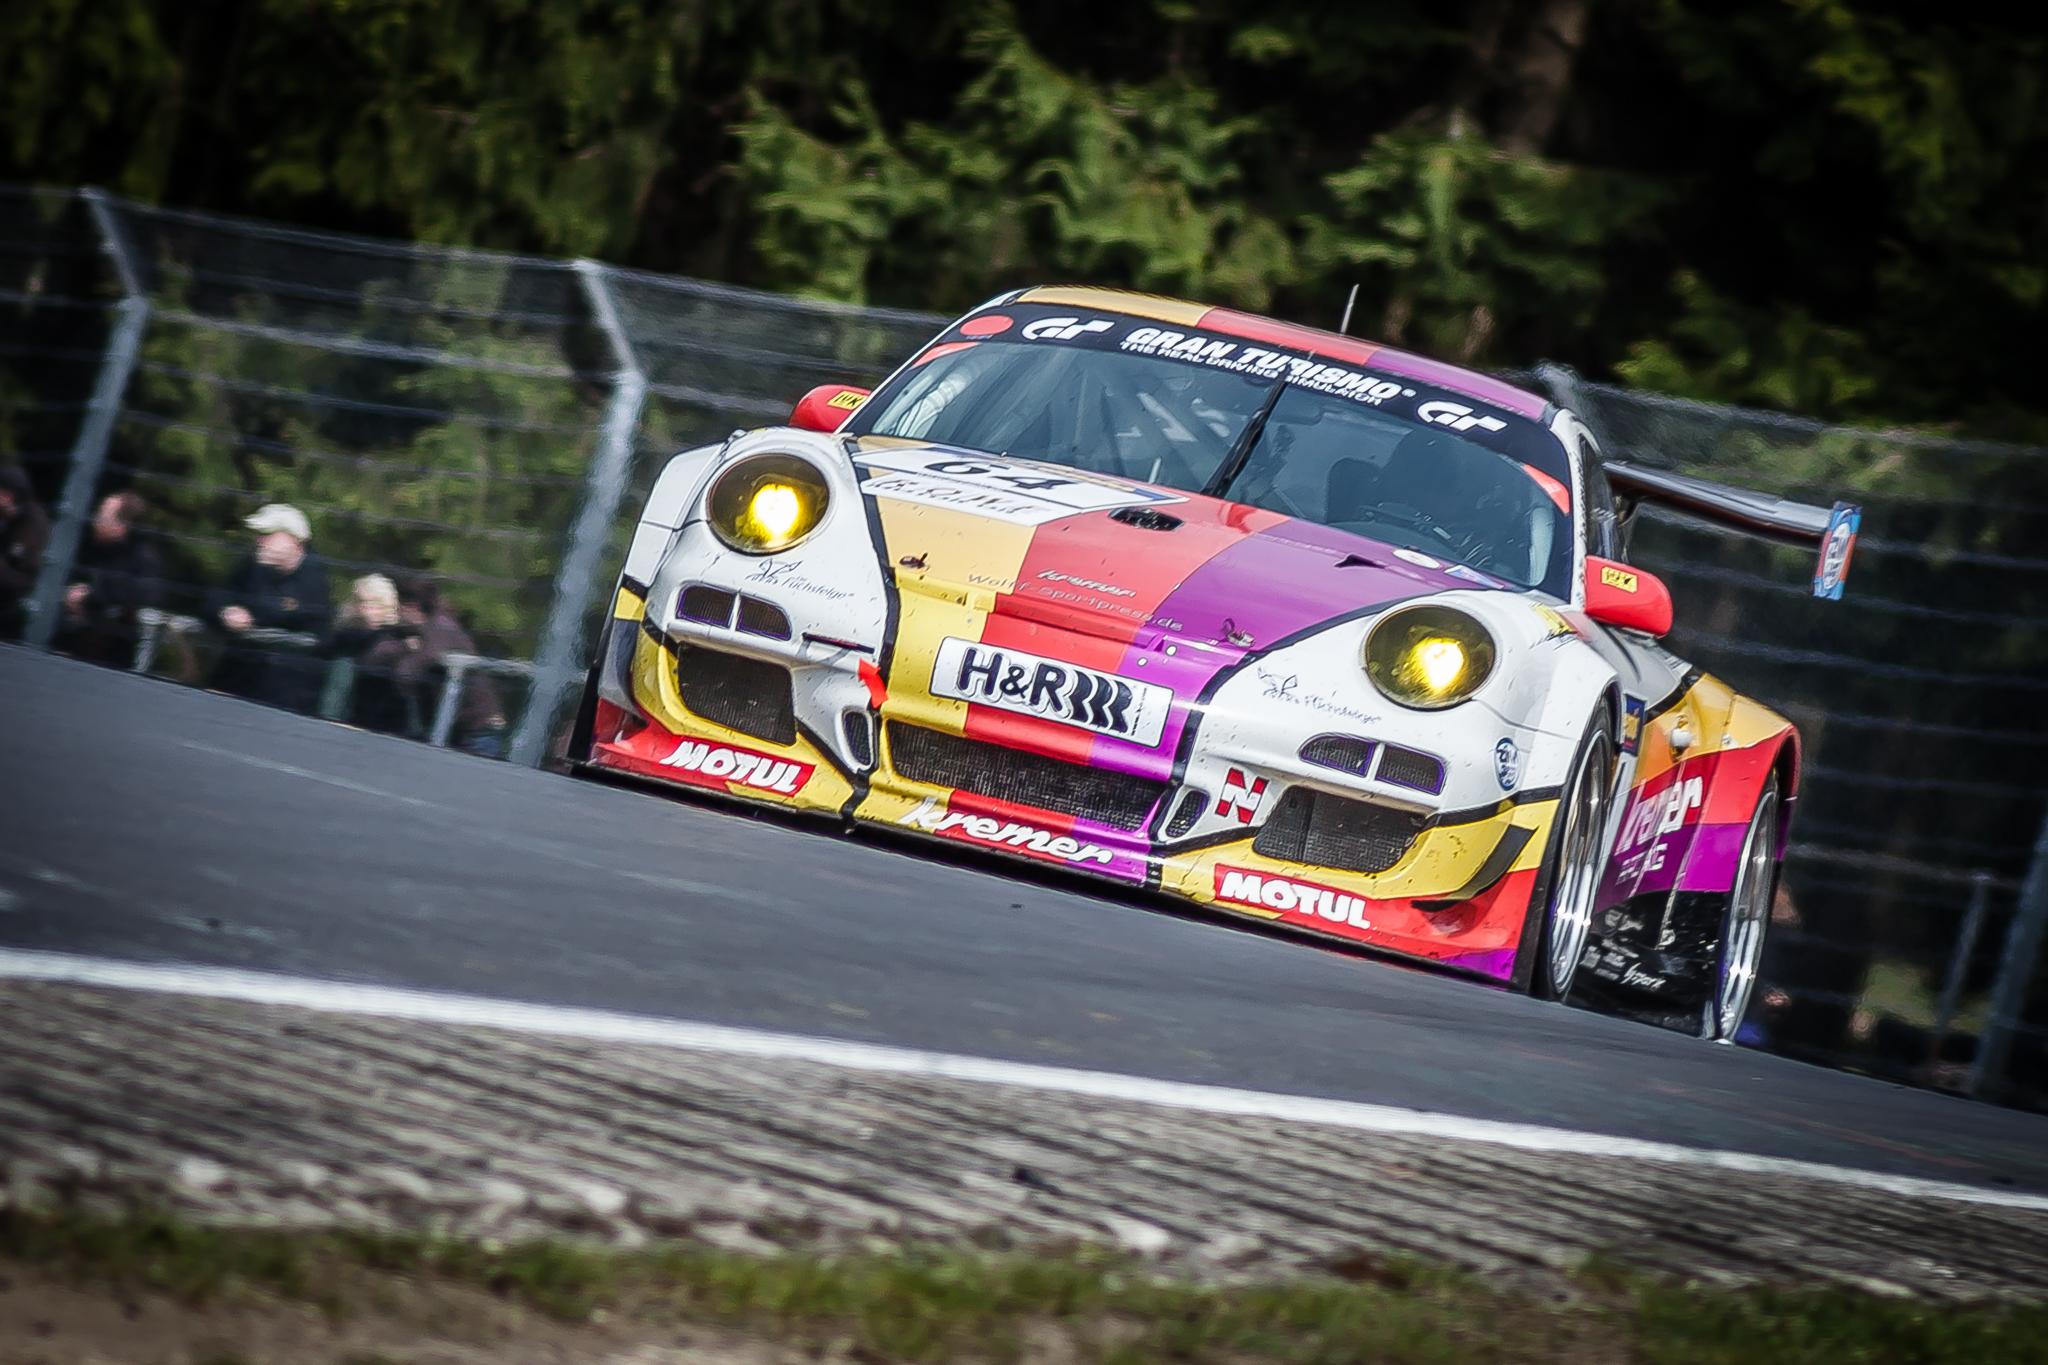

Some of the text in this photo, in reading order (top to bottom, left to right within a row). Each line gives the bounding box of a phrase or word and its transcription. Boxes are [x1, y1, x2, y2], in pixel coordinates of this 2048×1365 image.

[1126, 327, 1403, 399] GRAN TURISMO
[1205, 356, 1279, 378] DRIVING
[659, 740, 802, 793] MOTUL
[899, 797, 1114, 864] kremer
[1219, 870, 1371, 929] MOTUL
